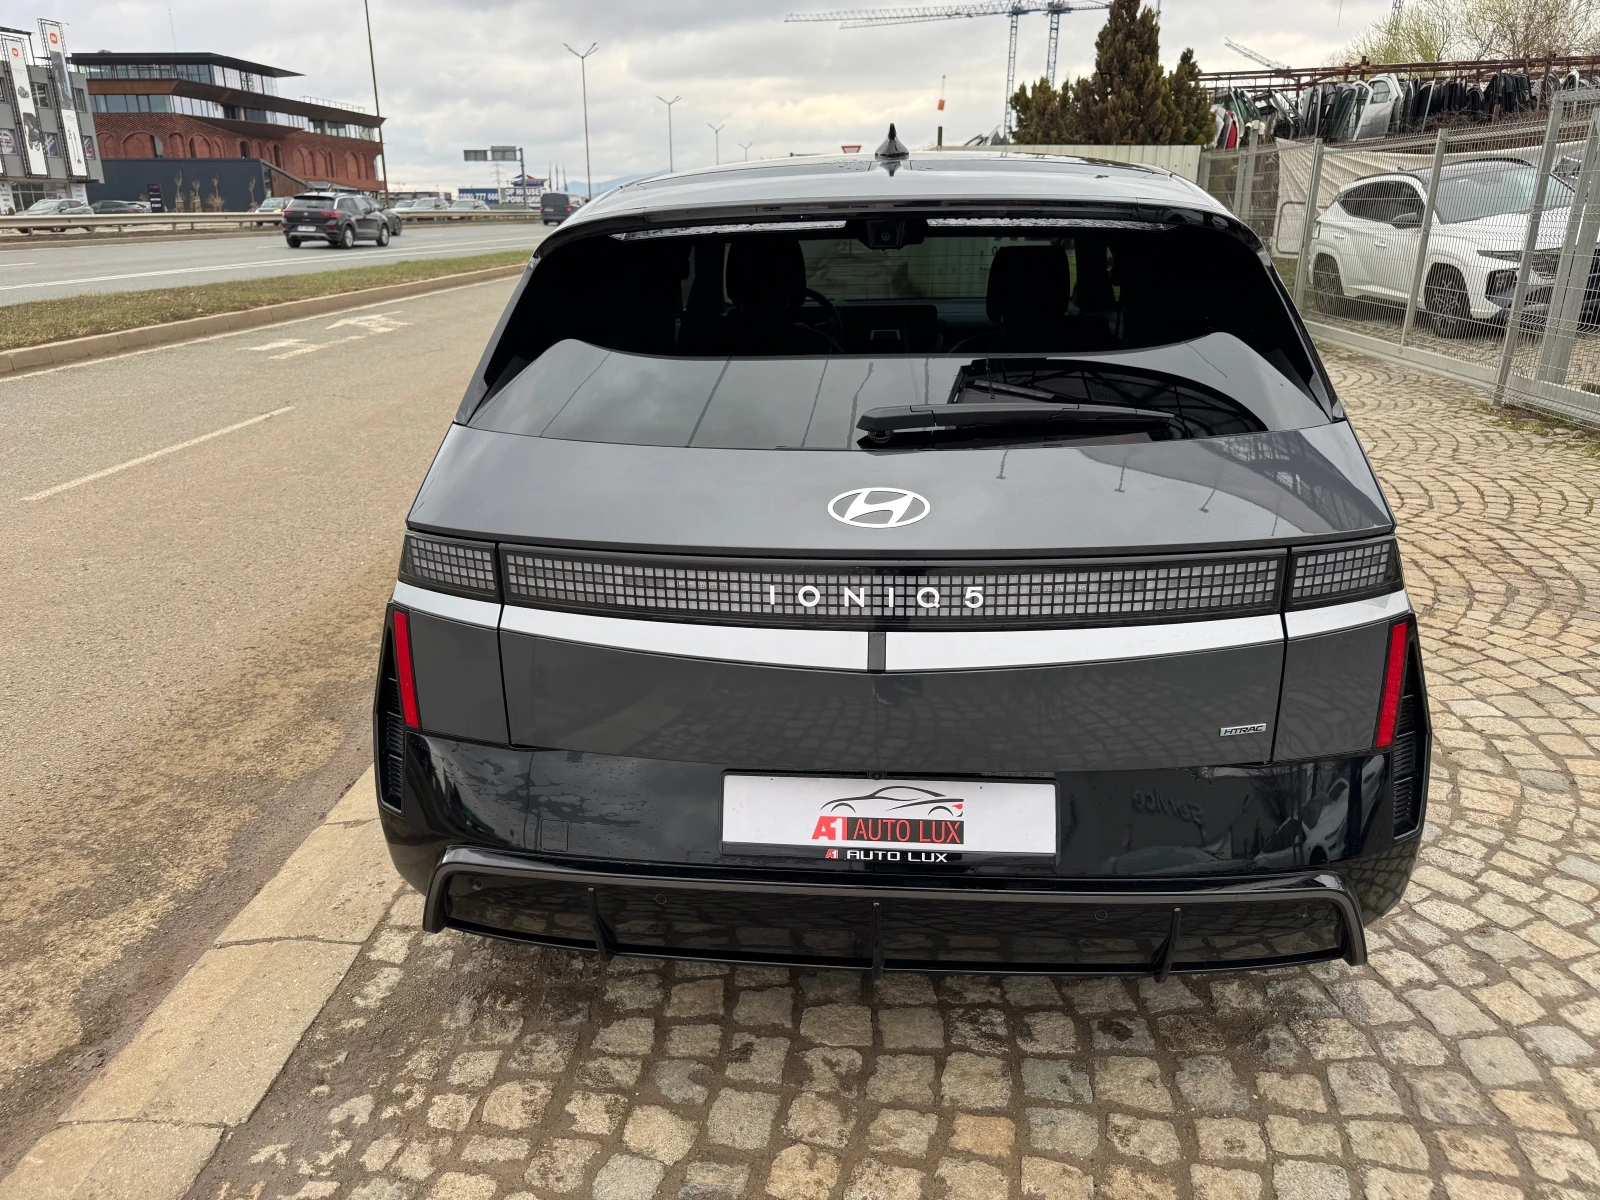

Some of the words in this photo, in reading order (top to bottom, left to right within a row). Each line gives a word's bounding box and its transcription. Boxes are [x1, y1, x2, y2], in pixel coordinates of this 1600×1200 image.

[770, 585, 940, 609] IONIQ
[964, 586, 984, 609] 5
[1223, 725, 1264, 735] HTRAC
[811, 815, 848, 841] A1
[852, 818, 911, 843] AUTO
[918, 820, 961, 844] LUX
[825, 849, 839, 859] A1
[846, 849, 900, 861] AUTO
[907, 851, 948, 863] LUX
